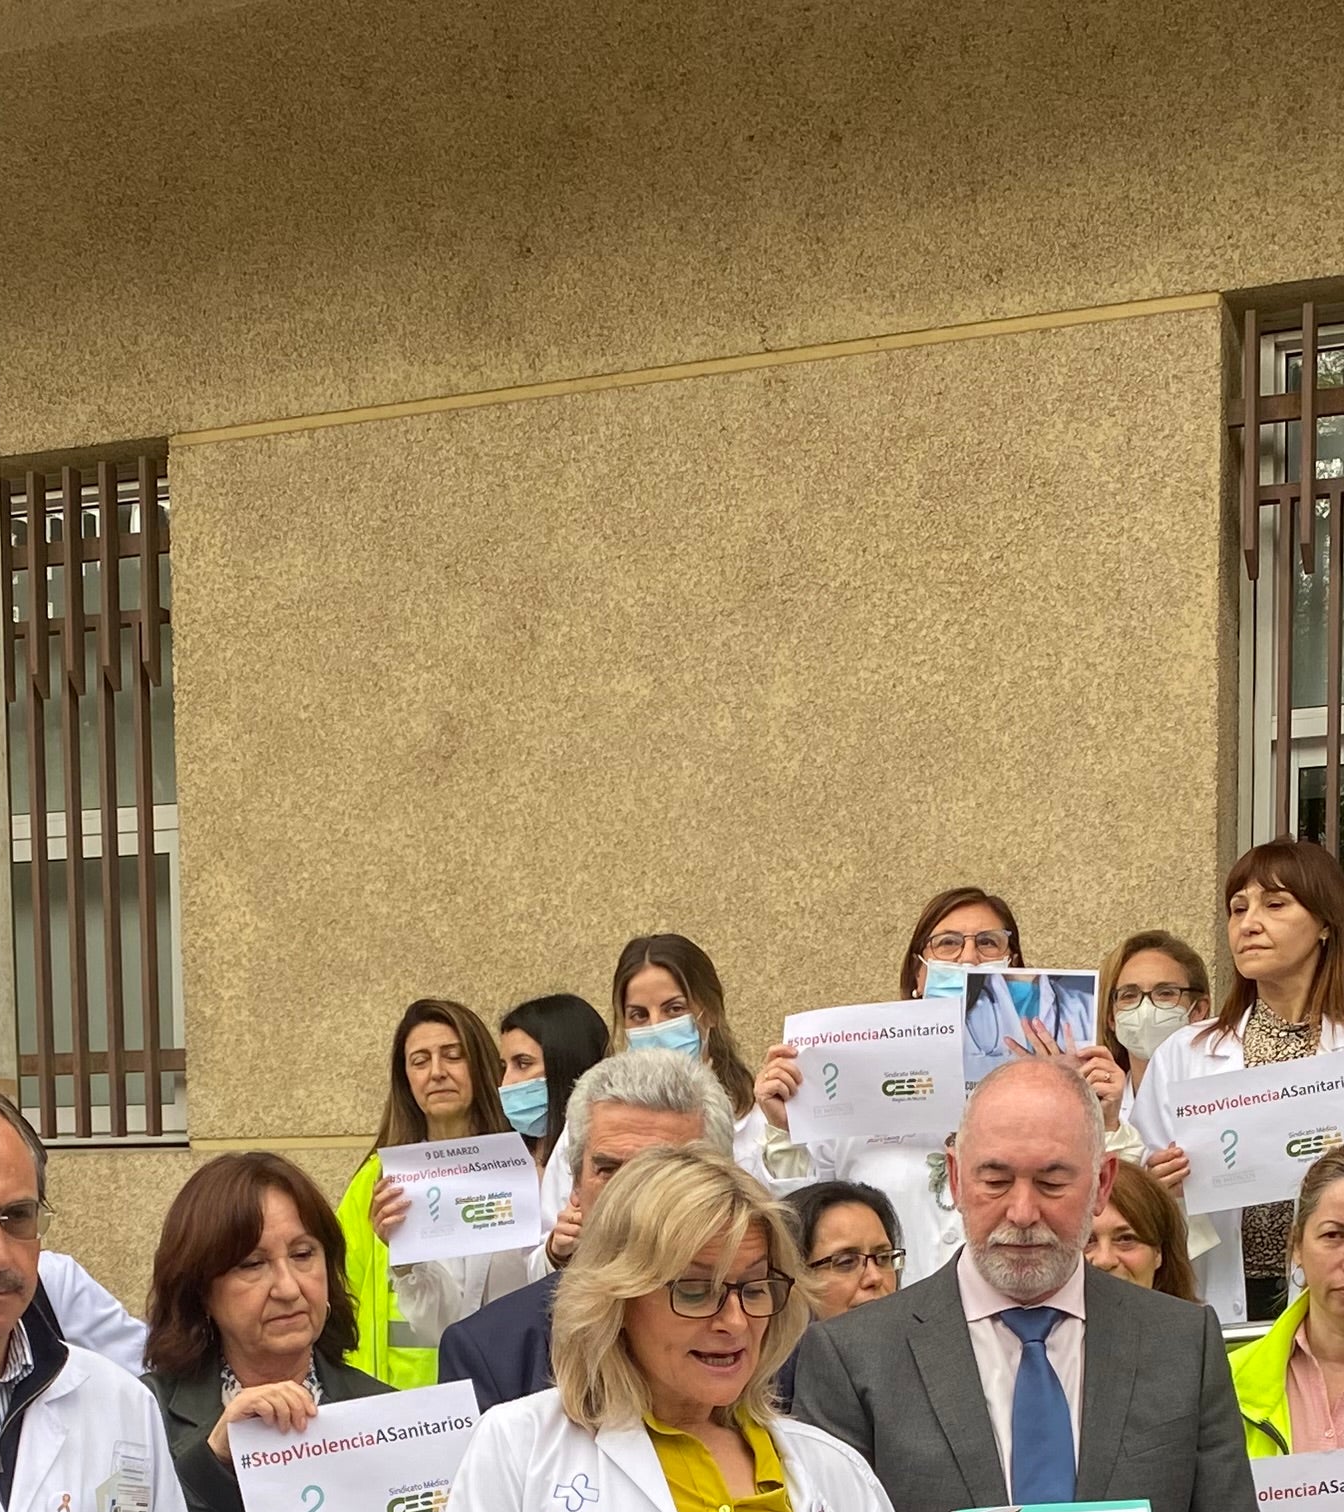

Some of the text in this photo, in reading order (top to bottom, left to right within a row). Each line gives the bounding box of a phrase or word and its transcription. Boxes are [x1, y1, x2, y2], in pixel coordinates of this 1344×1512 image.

[788, 1023, 955, 1048] #StopViolenciaASanitarios
[425, 1146, 480, 1160] 9 DE MARZO
[388, 1157, 527, 1184] #StopViolenciaASanitarios
[240, 1414, 473, 1469] #StopViolenciaASanitarios
[388, 1478, 449, 1496] Sindicato Médico
